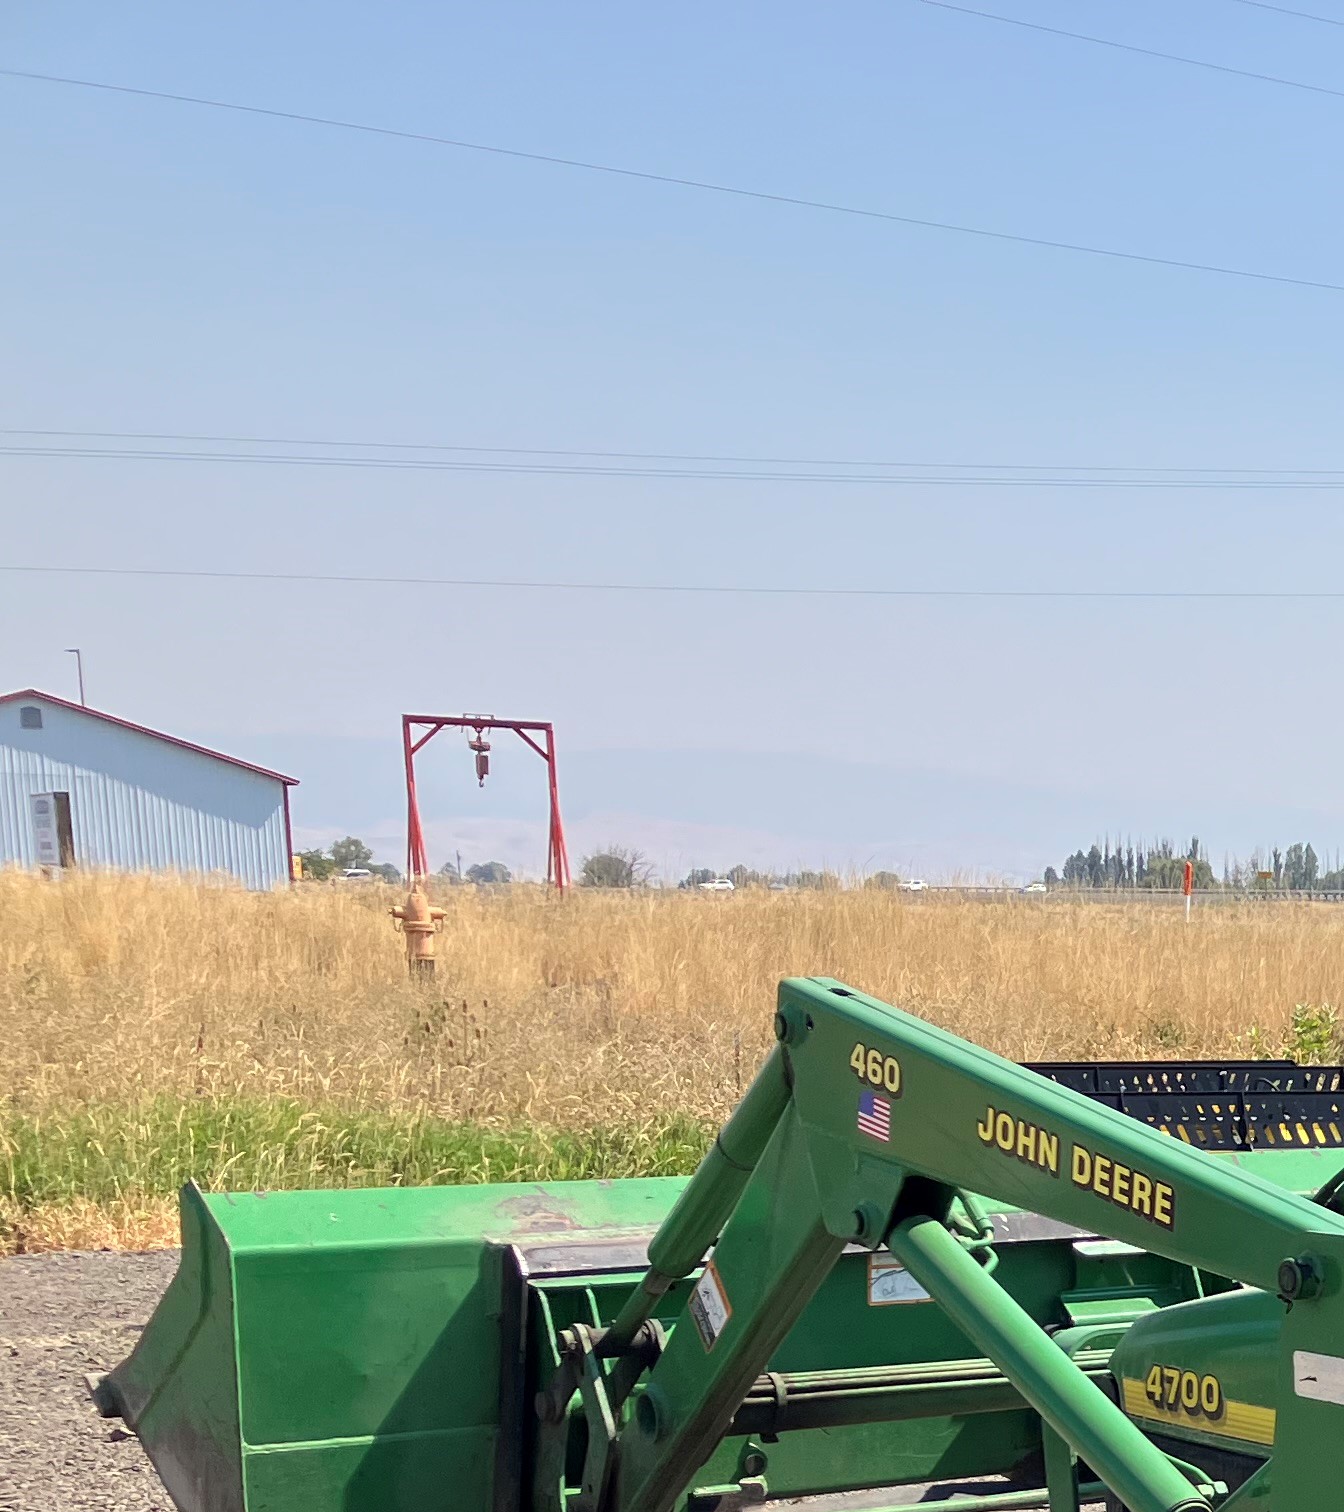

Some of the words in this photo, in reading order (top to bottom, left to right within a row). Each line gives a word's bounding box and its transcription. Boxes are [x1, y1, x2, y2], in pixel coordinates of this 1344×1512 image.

[850, 1042, 902, 1096] 460
[977, 1106, 1059, 1175] JOHN
[1071, 1144, 1174, 1229] DEERE
[1146, 1365, 1222, 1418] 4700
